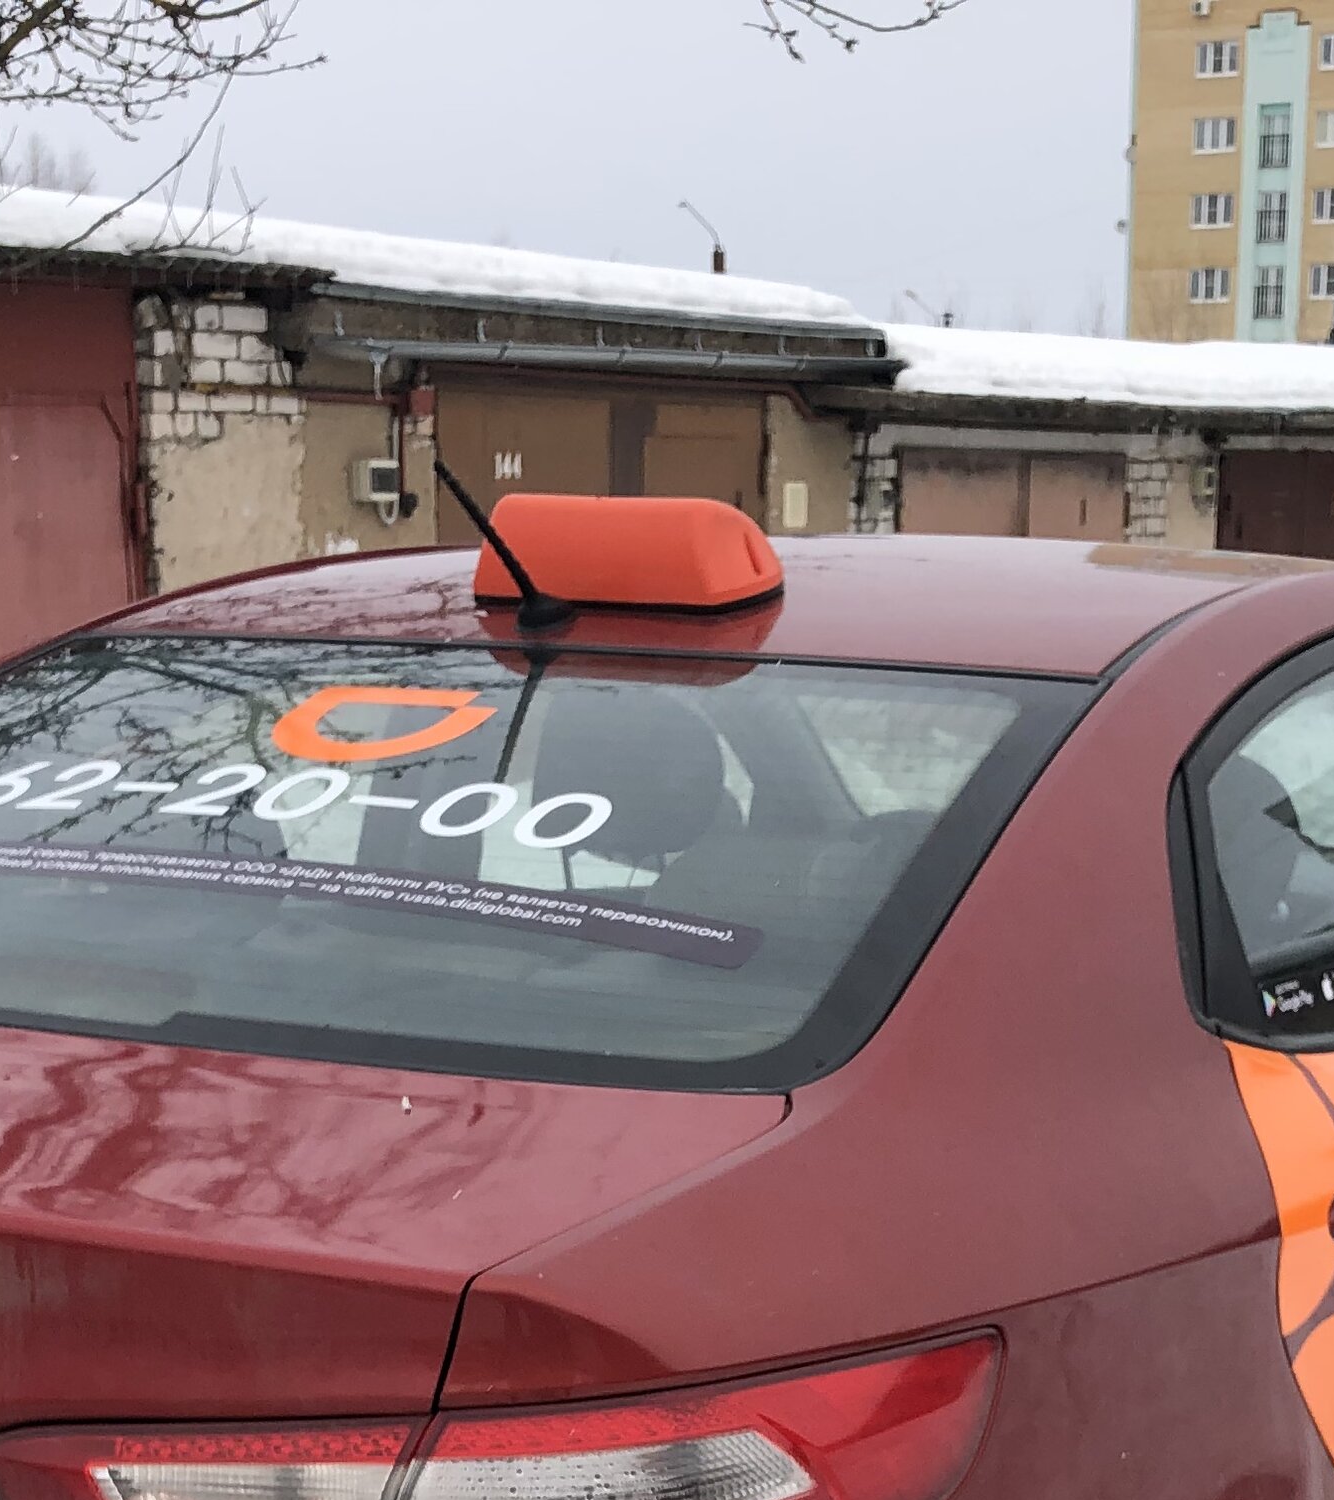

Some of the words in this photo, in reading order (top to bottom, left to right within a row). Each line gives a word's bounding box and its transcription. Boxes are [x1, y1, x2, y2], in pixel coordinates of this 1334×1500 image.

[223, 873, 295, 889] сервиса
[318, 884, 342, 894] на
[343, 885, 395, 900] сайте
[396, 892, 583, 927] russia.didiglobal.com
[233, 860, 277, 874] ООО
[335, 870, 423, 890] Мобилити
[424, 880, 471, 896] РУС»
[473, 887, 504, 901] (не
[507, 894, 588, 914] является
[590, 907, 735, 943] перевозчиком).
